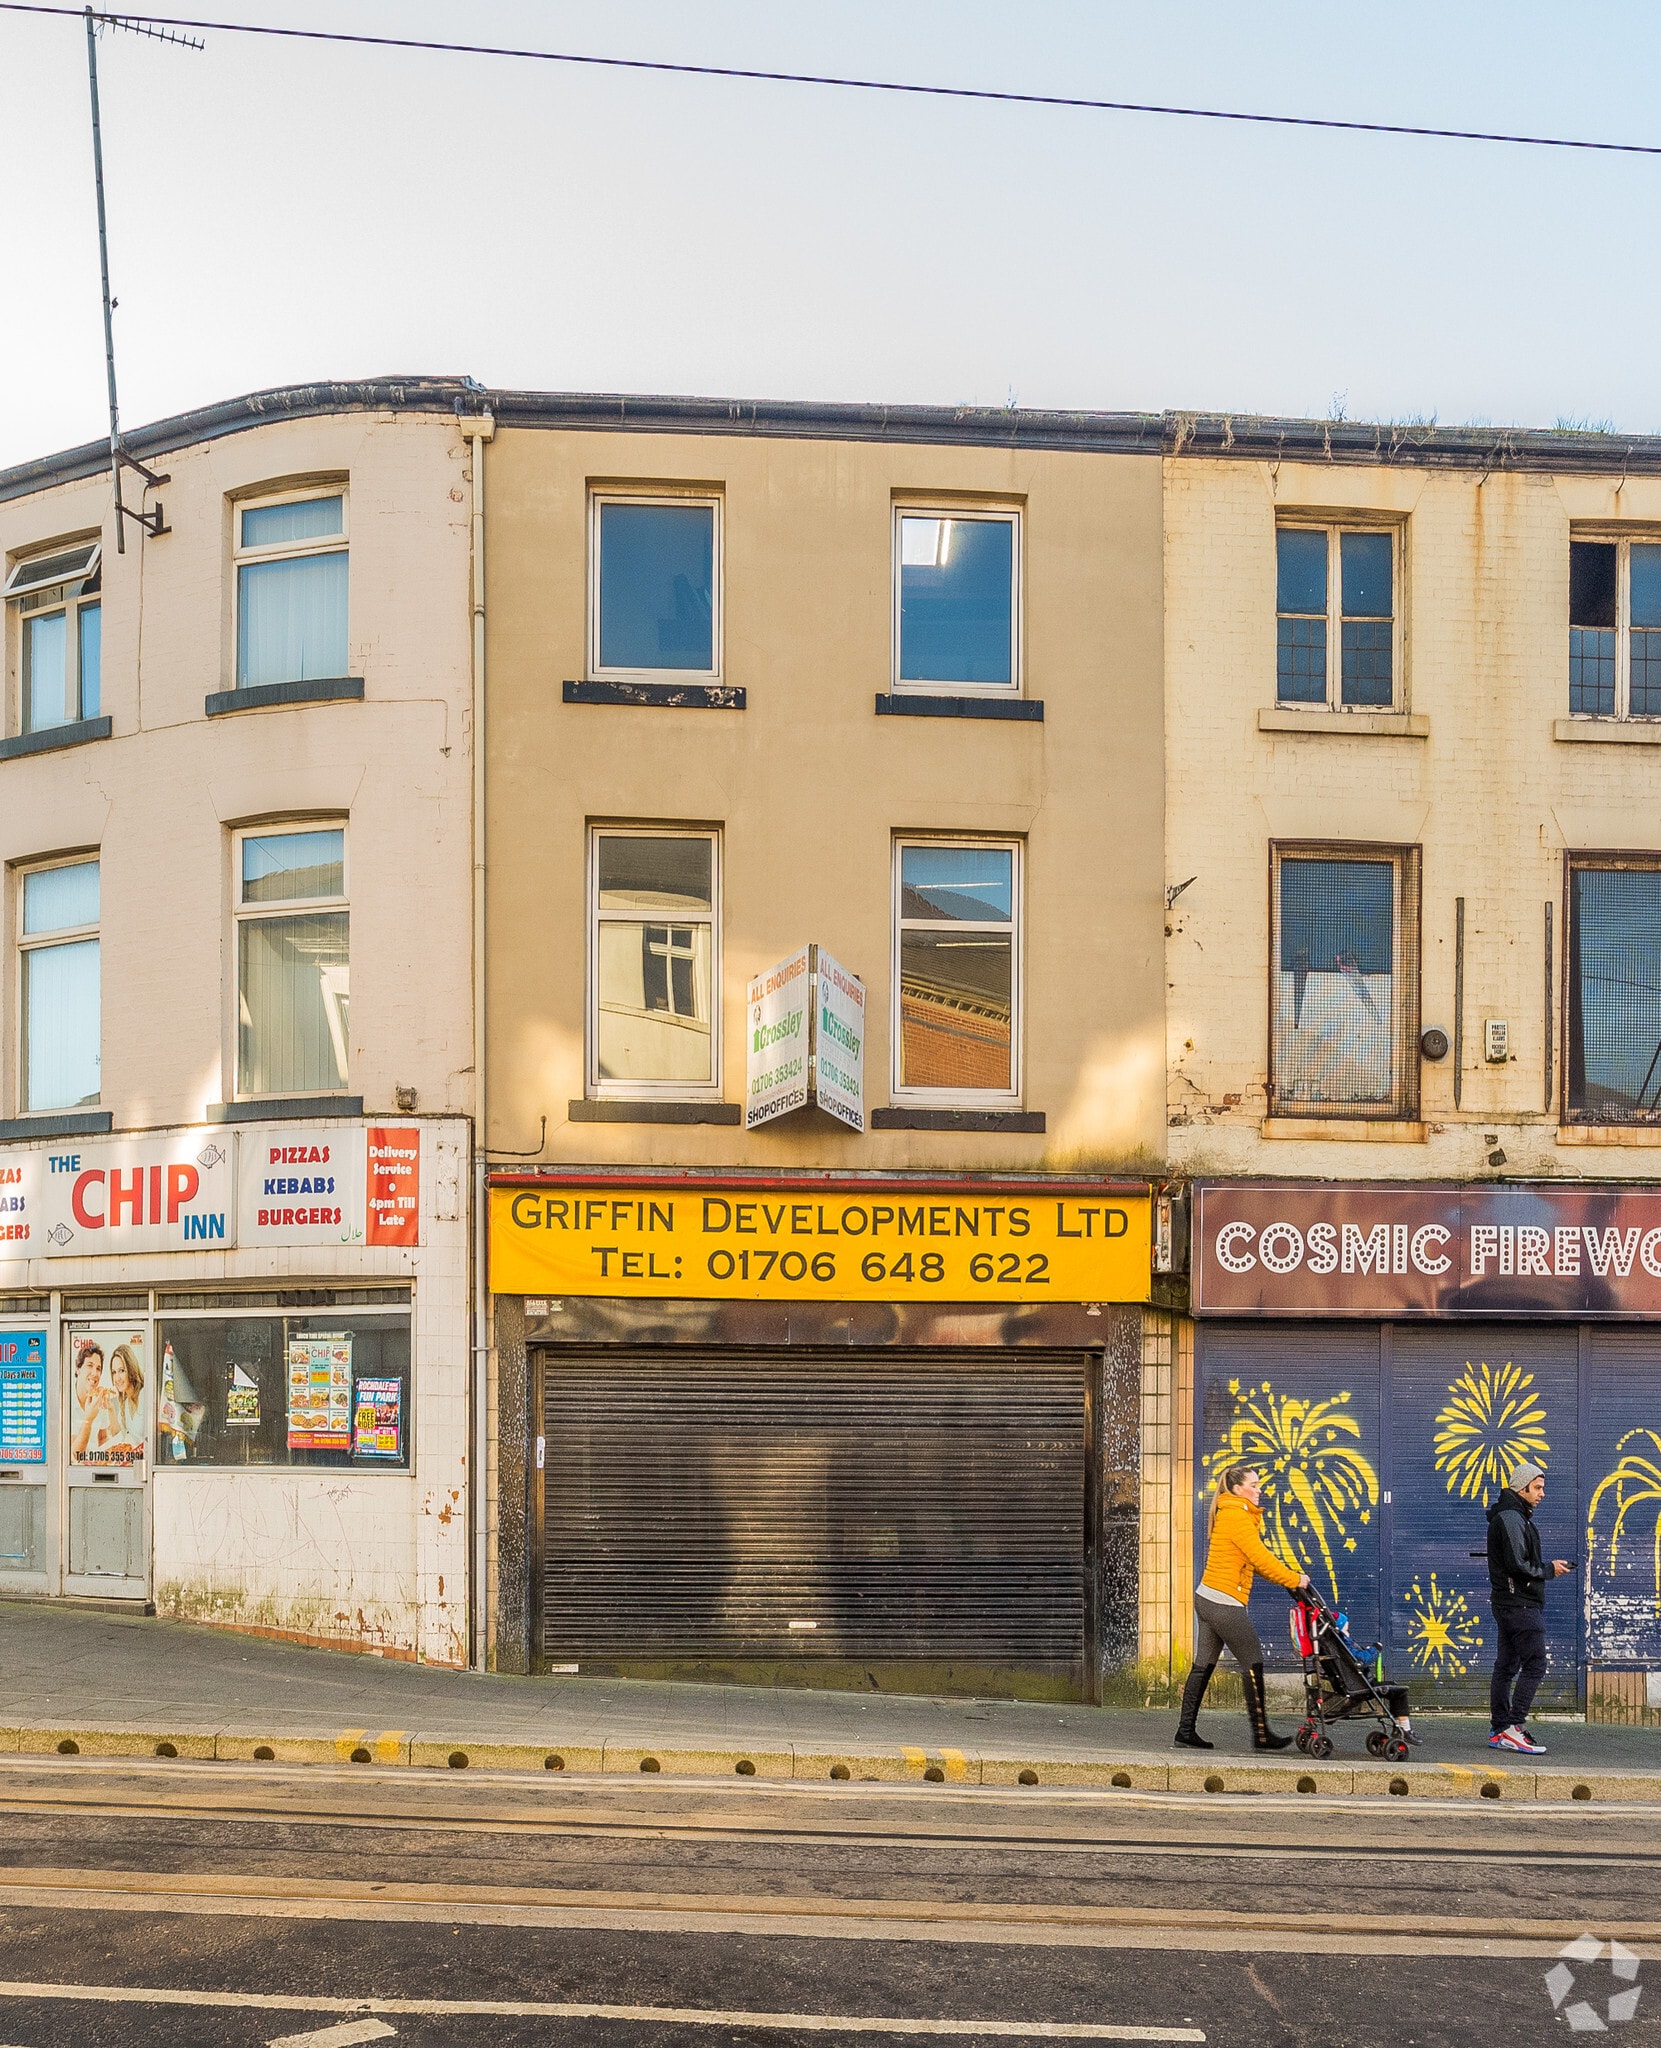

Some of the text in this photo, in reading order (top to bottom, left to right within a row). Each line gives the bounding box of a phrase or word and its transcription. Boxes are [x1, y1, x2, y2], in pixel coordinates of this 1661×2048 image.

[751, 955, 806, 1004] ALL ENQUIRIES
[820, 958, 863, 1007] ALL ENQUIRIES
[760, 1008, 803, 1050] Crossley
[828, 1010, 861, 1061] Crossley
[752, 1071, 773, 1095] 01706
[774, 1056, 803, 1085] 353424
[821, 1057, 838, 1084] 01706
[269, 1146, 331, 1165] PIZZAS
[369, 1146, 417, 1161] Delivery
[48, 1155, 81, 1173] THE
[373, 1163, 412, 1176] Service
[263, 1177, 336, 1195] KEBABS
[71, 1164, 200, 1229] CHIP
[368, 1197, 416, 1210] 4pm Till
[257, 1207, 343, 1226] BURGERS
[379, 1214, 406, 1226] Late
[511, 1192, 1129, 1238] GRIFFIN DEVELOPMENTS LTD
[184, 1213, 226, 1241] INN
[340, 1222, 363, 1242] حلال
[1215, 1221, 1453, 1276] COSMIC
[591, 1246, 1050, 1284] TEL: 01706 648 622
[0, 1344, 17, 1362] IP
[311, 1348, 331, 1358] CHIP
[4, 1371, 16, 1380] Days
[21, 1371, 36, 1379] Week
[358, 1380, 389, 1391] ROCHDALE
[359, 1391, 397, 1402] FUN PARK
[357, 1421, 375, 1429] RIDES
[358, 1412, 375, 1421] FREE
[14, 1449, 28, 1459] 355
[29, 1449, 42, 1459] 399
[76, 1451, 88, 1461] Tel:
[89, 1451, 109, 1461] 01706
[110, 1451, 124, 1462] 355
